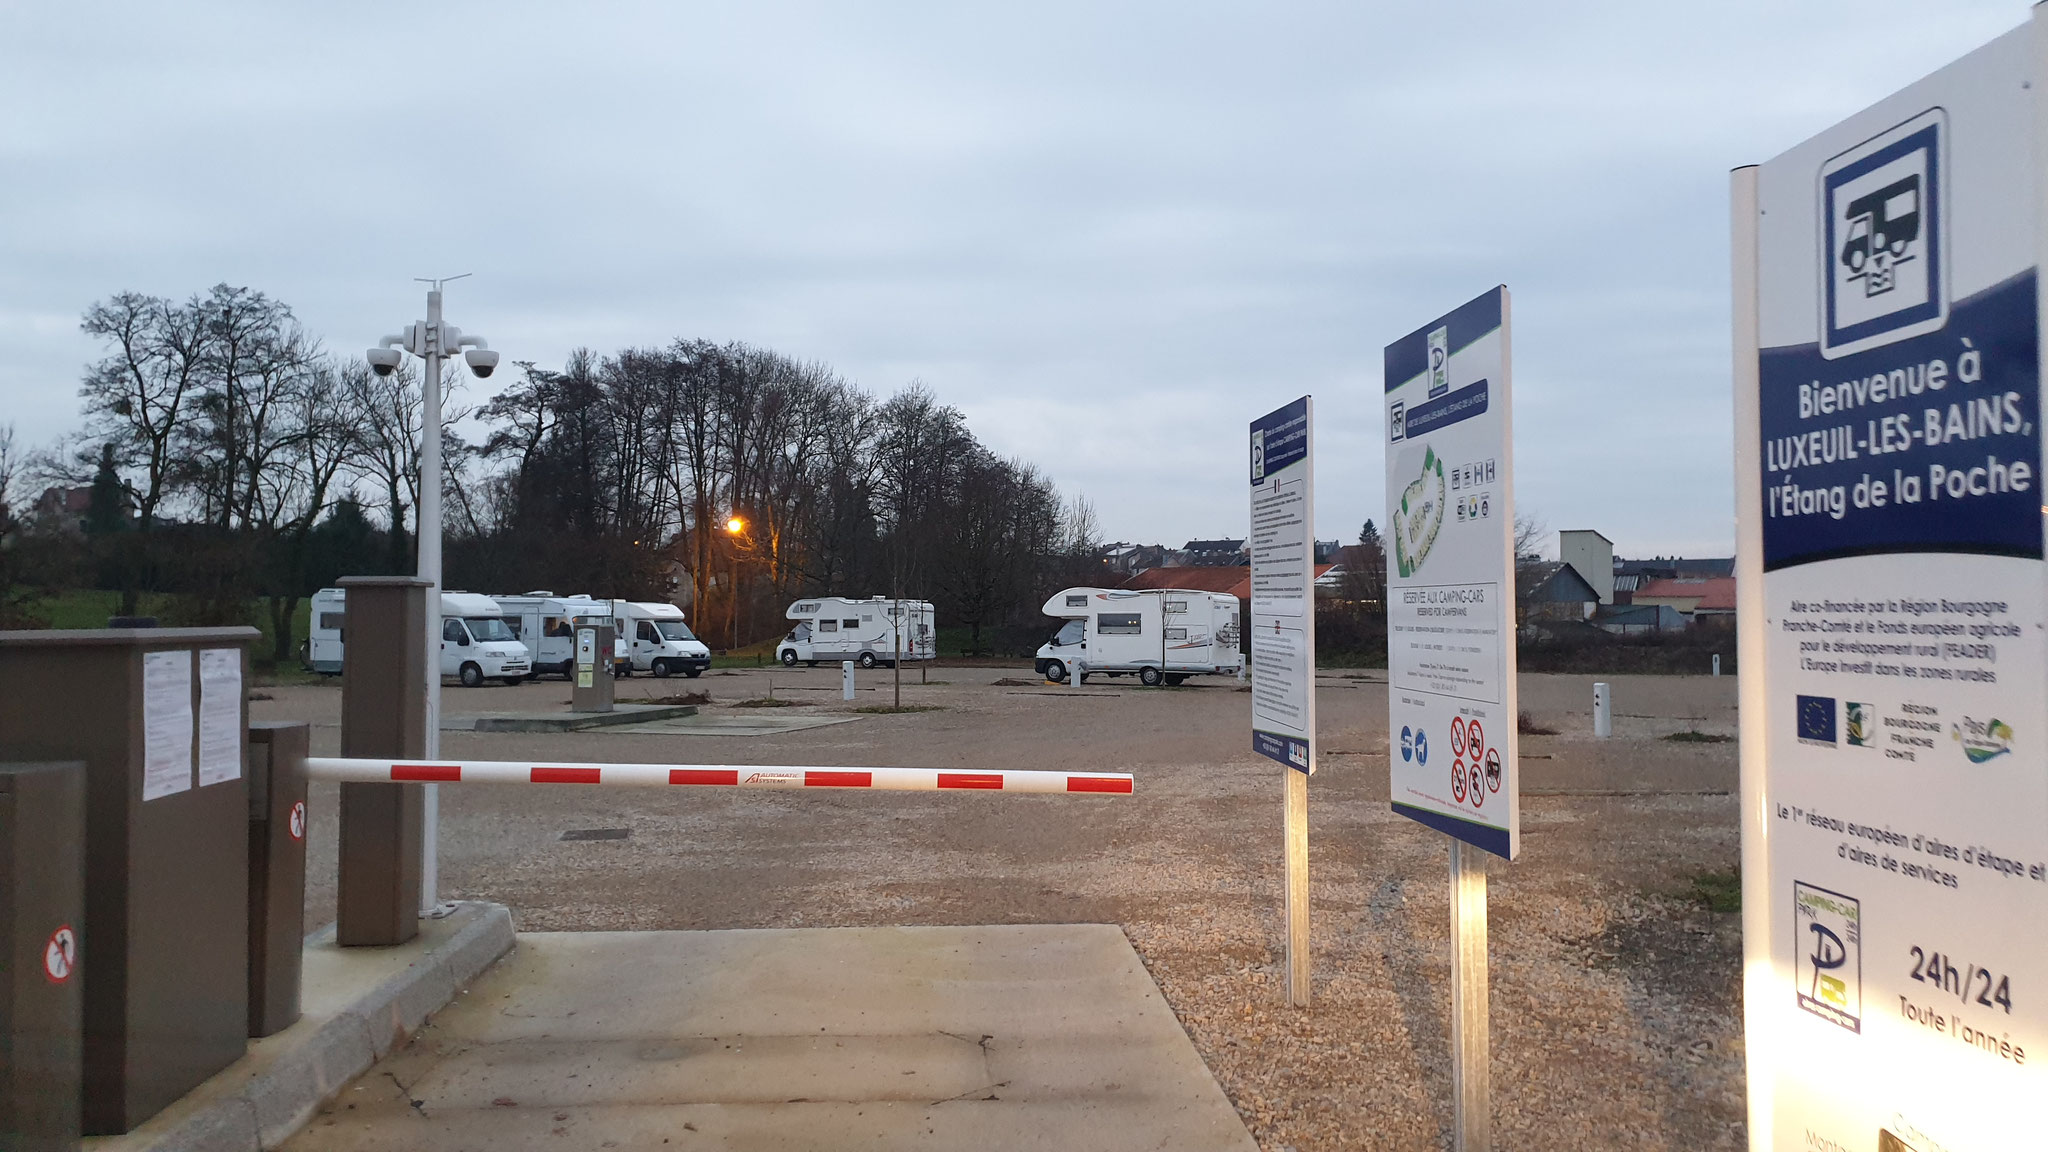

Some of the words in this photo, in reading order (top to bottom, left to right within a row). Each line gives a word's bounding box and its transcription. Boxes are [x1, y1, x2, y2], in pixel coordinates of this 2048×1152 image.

[1798, 359, 1948, 419] Bienvenue
[1957, 337, 1981, 383] à
[1767, 391, 2032, 472] LUXEUIL-LES-BAINS,
[1769, 475, 1846, 520] l'Étang
[1853, 473, 1888, 509] de
[1894, 469, 1921, 504] la
[1929, 455, 2032, 500] Poche
[1783, 618, 1852, 634] Franche-Comté
[1854, 620, 1864, 633] et
[1866, 620, 1875, 633] le
[1878, 620, 1908, 634] Fonds
[1910, 622, 1966, 638] européen
[1968, 621, 2021, 640] agricole
[1790, 599, 1807, 613] Aire
[1868, 602, 1885, 616] par
[1888, 600, 1897, 613] la
[1901, 598, 1938, 617] Région
[1941, 598, 2008, 617] Bourgogne
[1800, 641, 1819, 655] pour
[1822, 639, 1830, 652] le
[1833, 640, 1911, 658] développement
[1914, 643, 1939, 657] rural
[1942, 642, 1997, 664] (FEADER)
[1840, 658, 1872, 674] investit
[1875, 662, 1900, 676] dans
[1902, 662, 1917, 677] les
[1920, 667, 1952, 680] zones
[1954, 667, 1997, 684] rurales
[1776, 802, 1789, 820] Le
[1806, 807, 1844, 833] réseau
[1847, 824, 1909, 848] européen
[1912, 833, 1959, 861] d'aires
[1962, 845, 2025, 878] d'étape
[2029, 862, 2047, 882] et
[1837, 842, 1878, 867] d'aires
[1881, 853, 1899, 873] de
[1901, 862, 1958, 889] services
[1908, 945, 2013, 1015] 24h/24
[1899, 994, 1946, 1033] Toute
[1951, 1014, 2026, 1065] l'année
